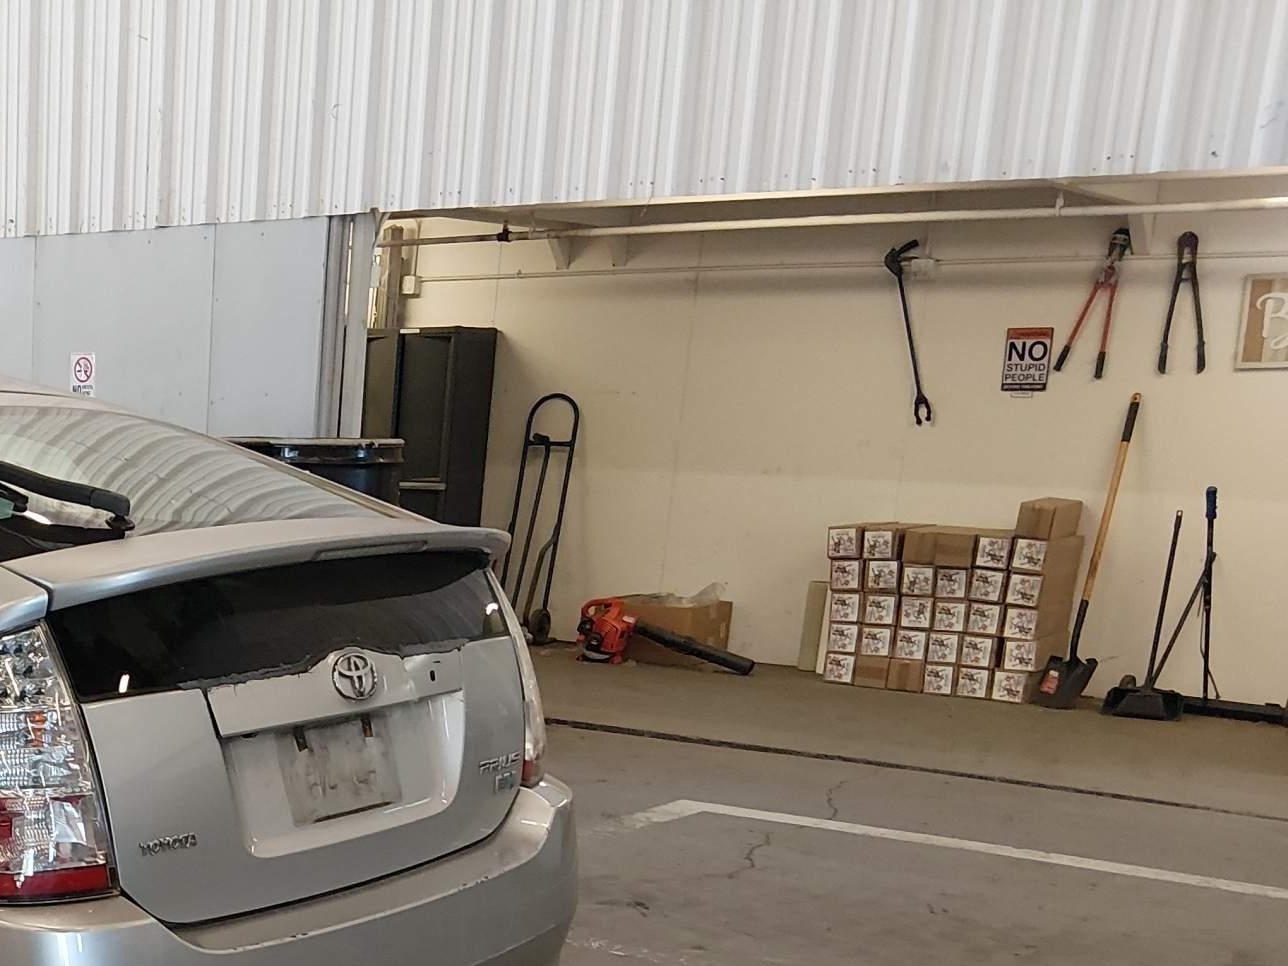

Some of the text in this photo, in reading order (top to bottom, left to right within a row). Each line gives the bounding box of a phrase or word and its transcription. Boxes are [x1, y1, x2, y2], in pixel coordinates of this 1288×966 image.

[1008, 340, 1048, 361] NO
[1006, 363, 1046, 372] STUPID
[1004, 373, 1045, 382] PEOPLE
